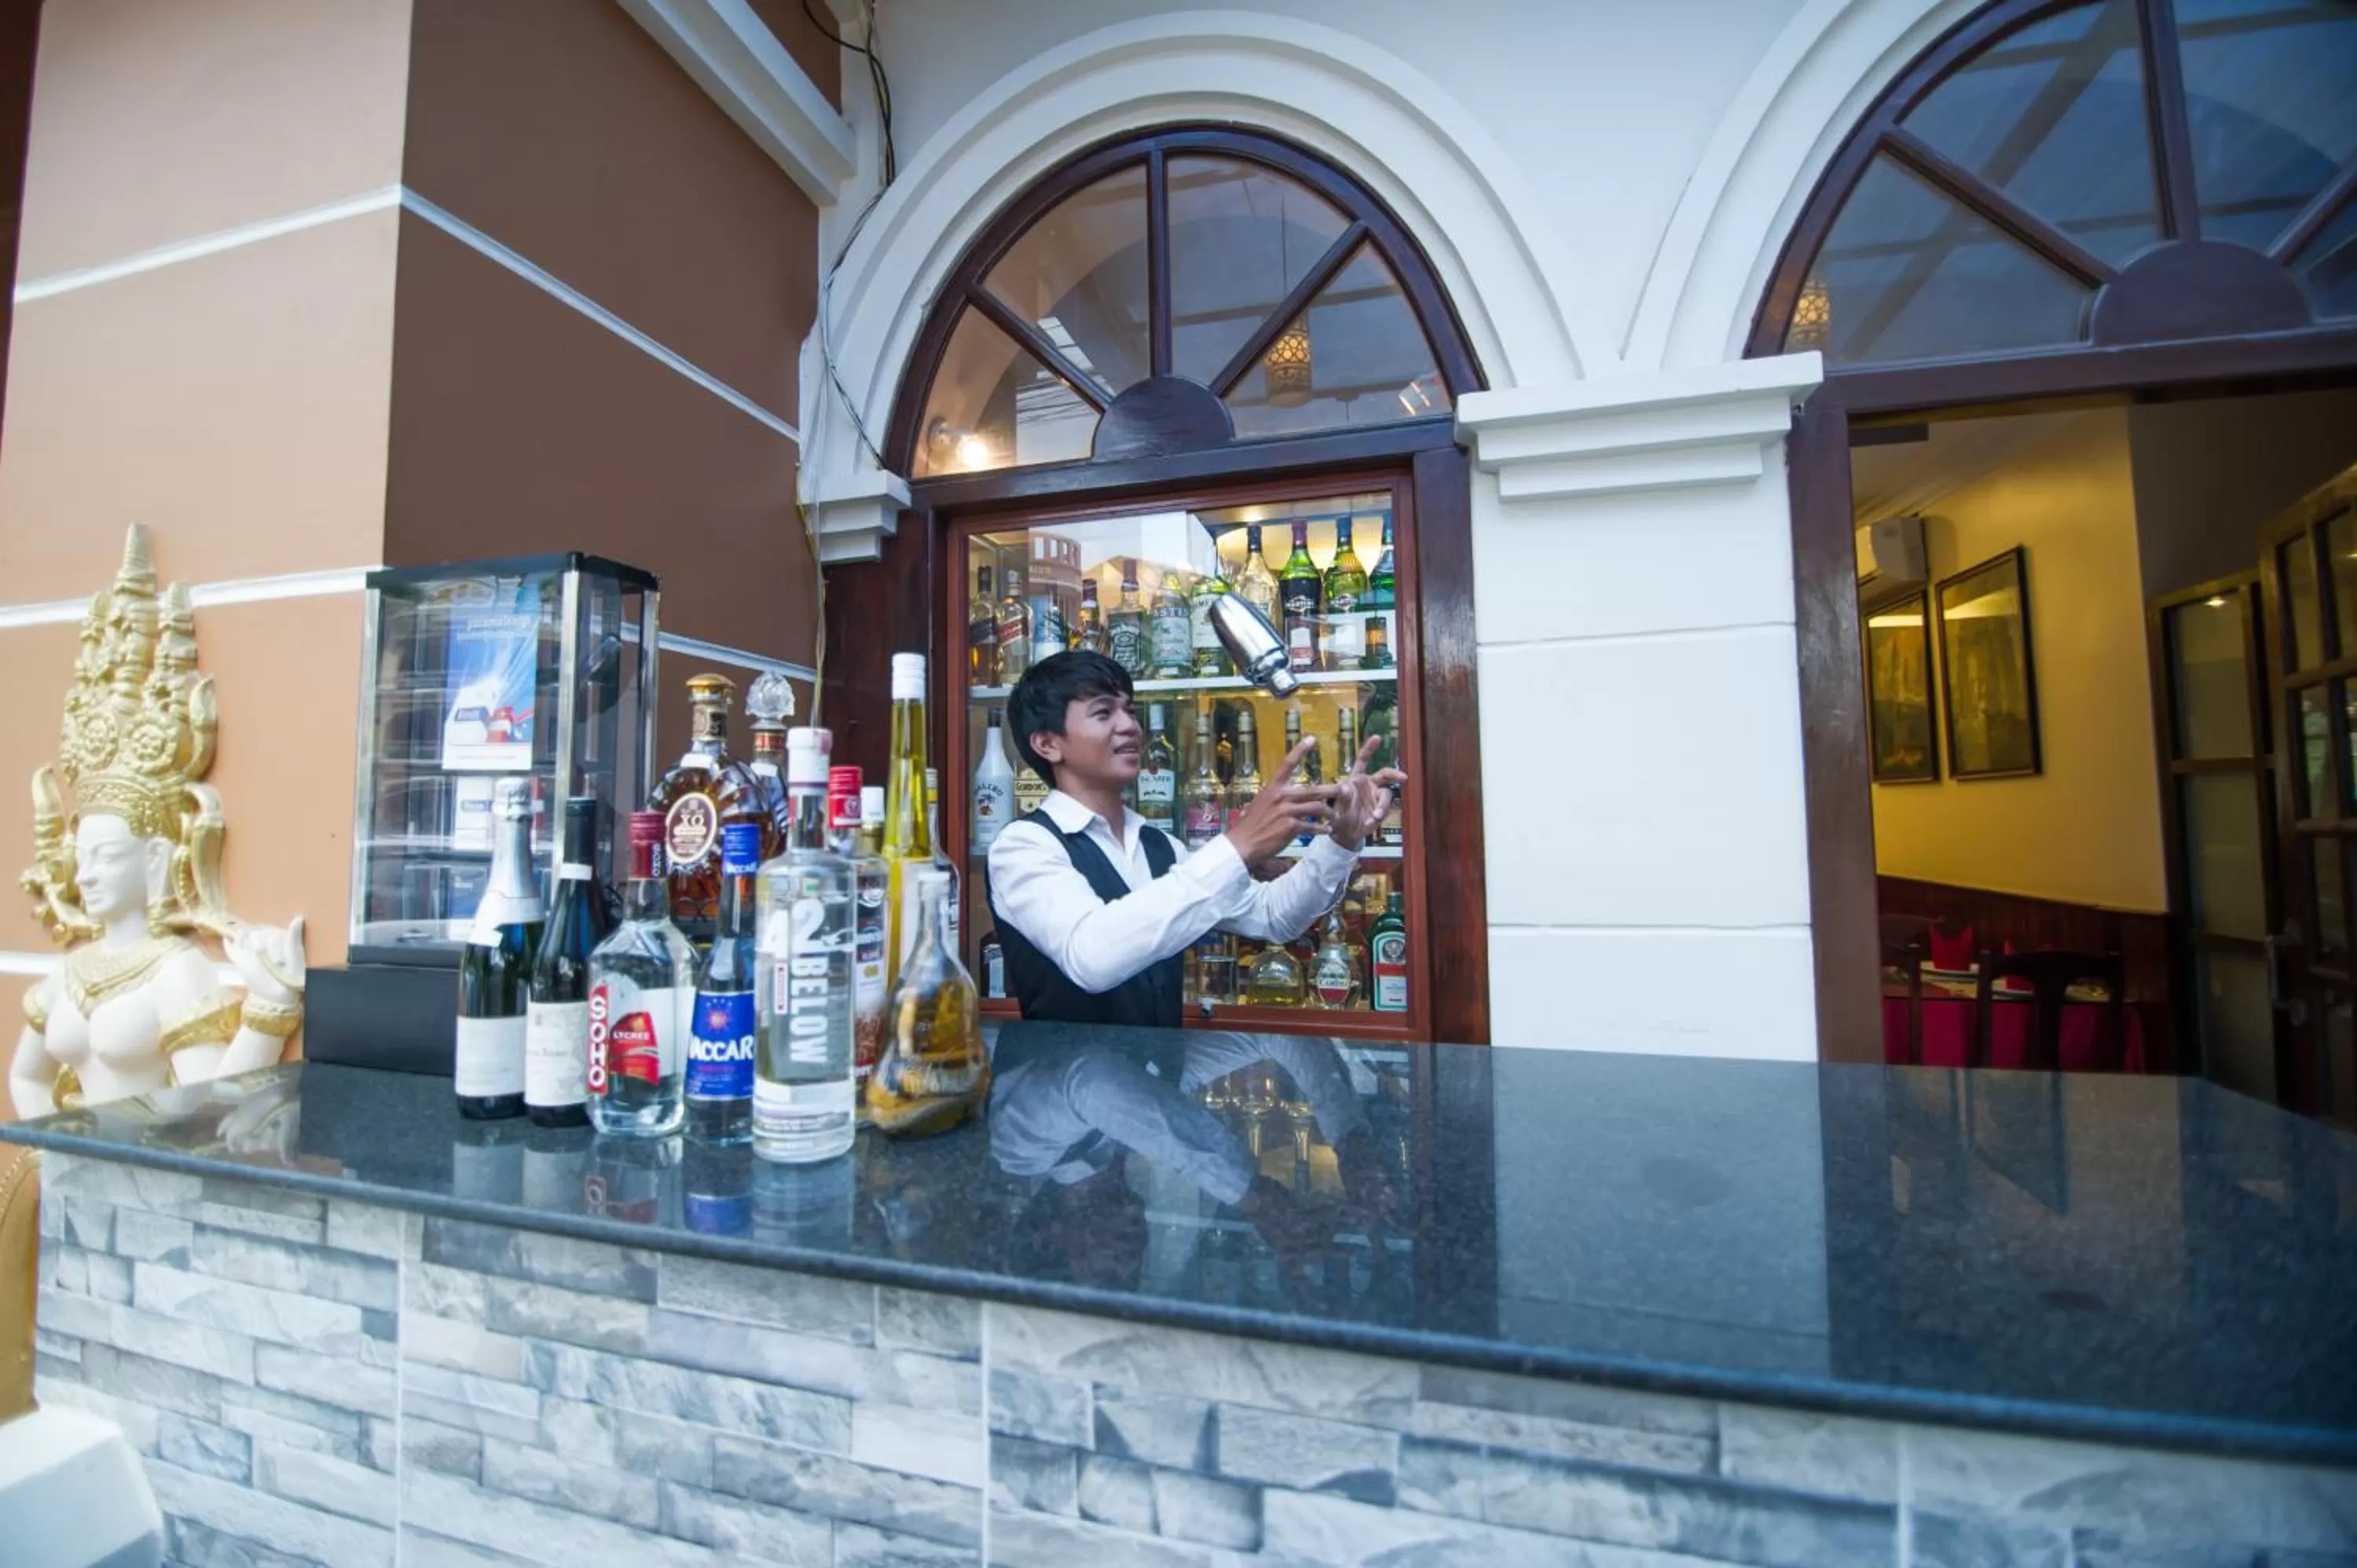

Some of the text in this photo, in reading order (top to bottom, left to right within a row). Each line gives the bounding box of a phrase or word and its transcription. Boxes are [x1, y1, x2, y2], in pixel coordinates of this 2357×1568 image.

[680, 815, 705, 826] XO
[757, 898, 827, 958] 42
[790, 956, 828, 1062] BELOW
[590, 995, 607, 1087] SOHO
[690, 1034, 753, 1061] ACCAR
